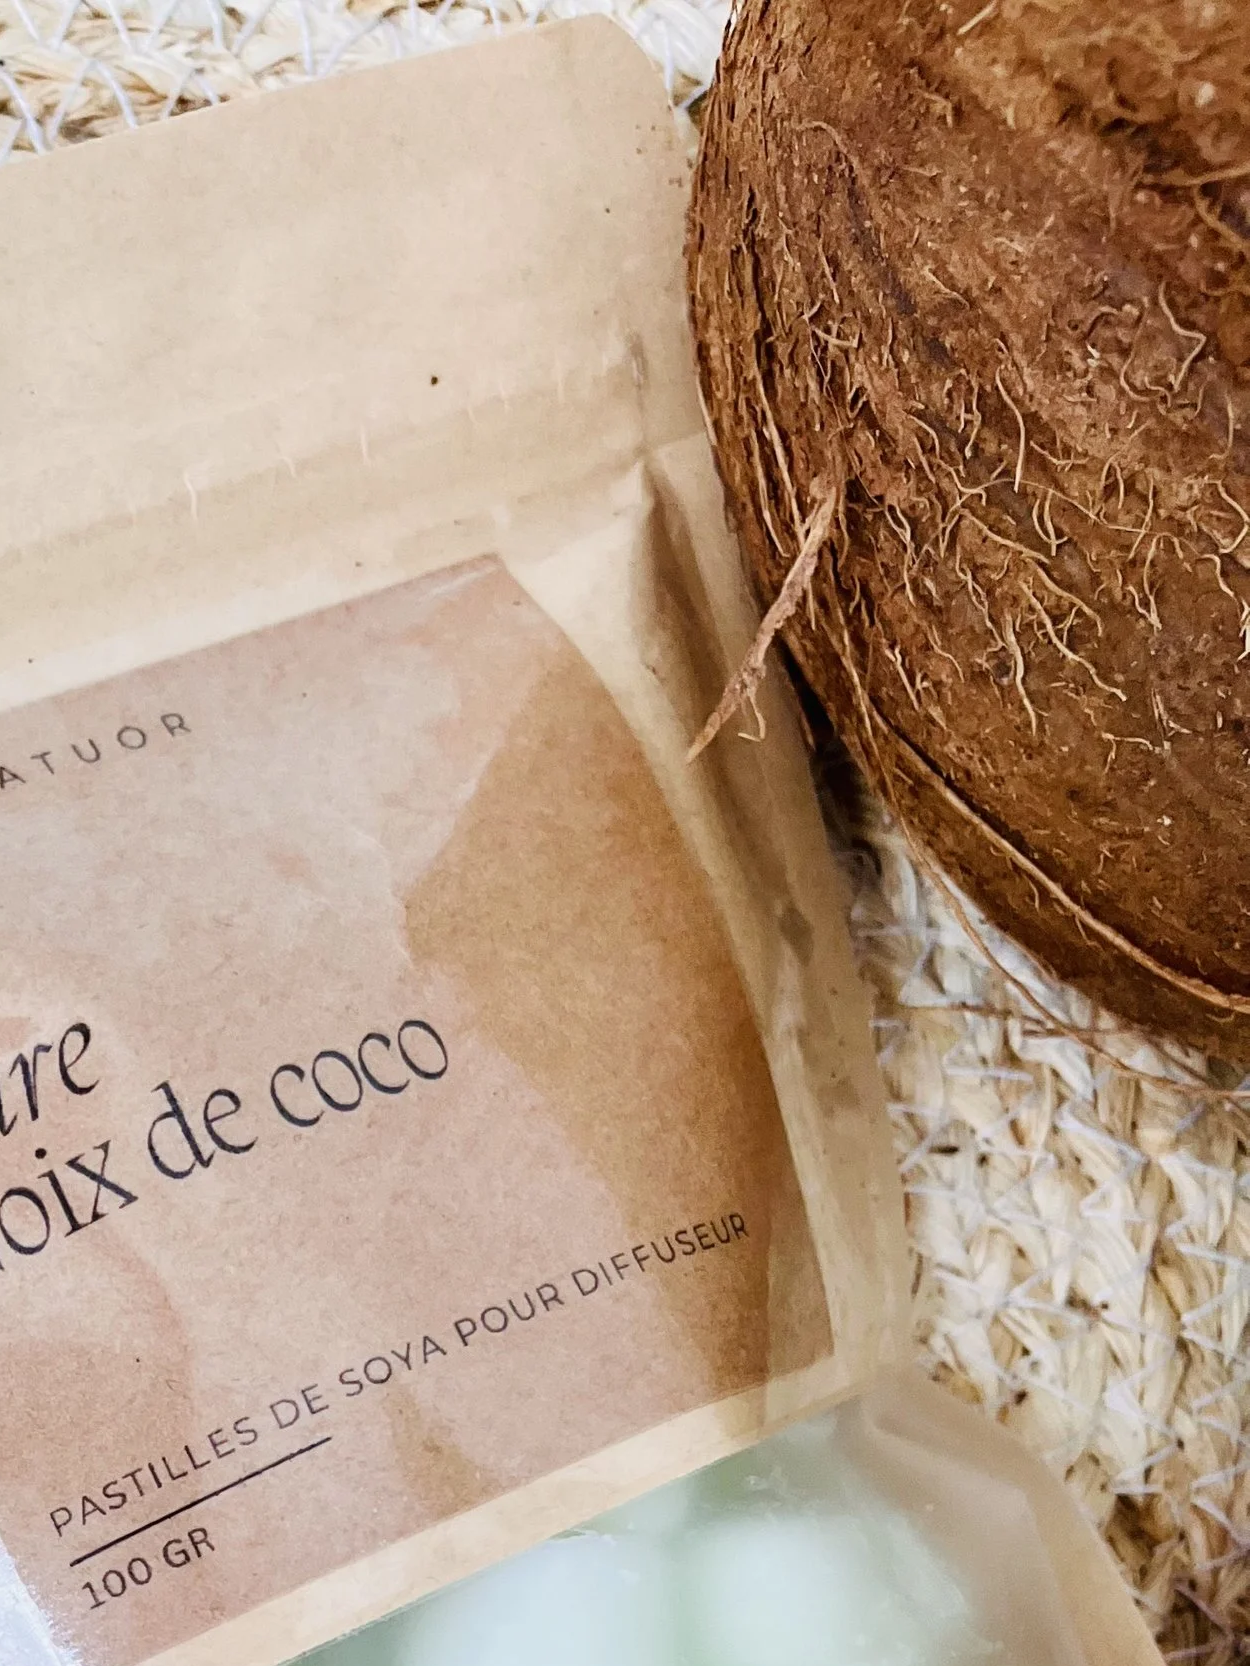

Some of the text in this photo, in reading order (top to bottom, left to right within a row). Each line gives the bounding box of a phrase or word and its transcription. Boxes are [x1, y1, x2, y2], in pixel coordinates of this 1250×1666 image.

[146, 1081, 258, 1180] de
[269, 1019, 450, 1127] coco
[49, 1211, 751, 1538] PASTILLES DE SOYA POUR DIFFUSEUR
[80, 1526, 218, 1611] 100 GR
